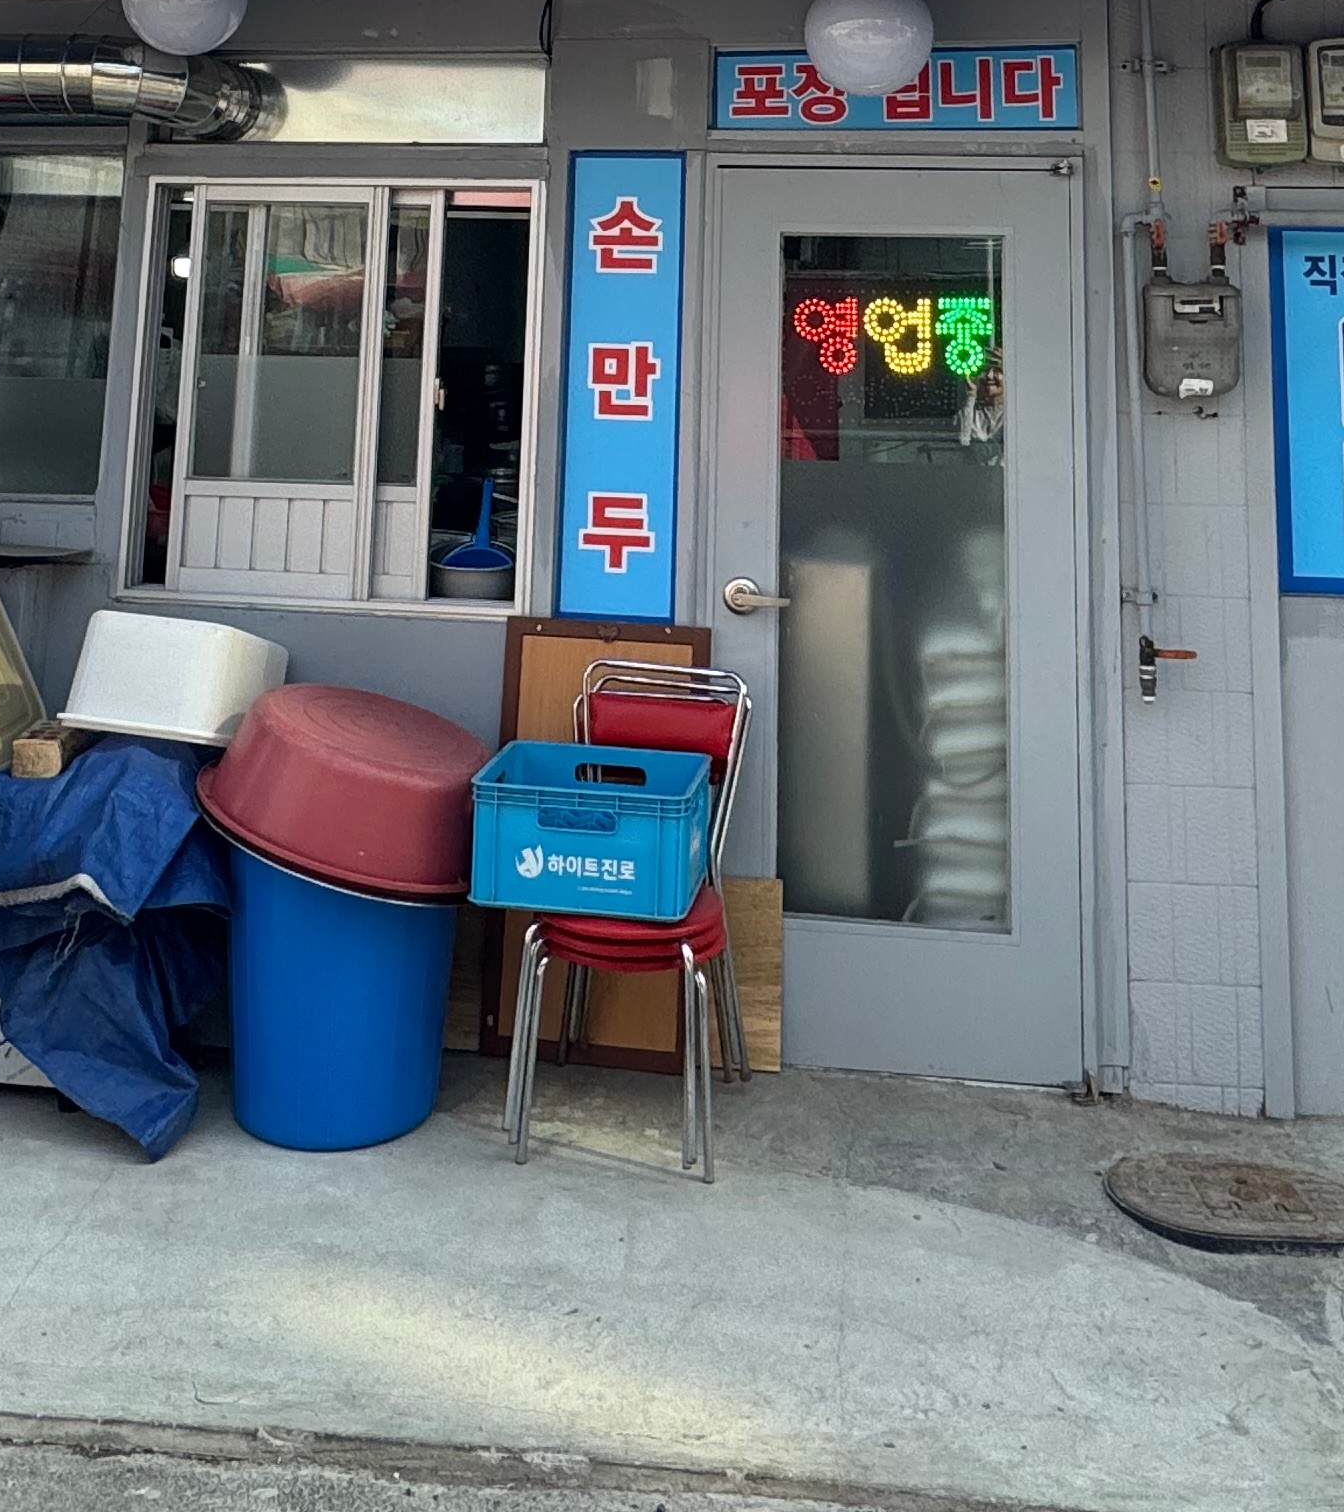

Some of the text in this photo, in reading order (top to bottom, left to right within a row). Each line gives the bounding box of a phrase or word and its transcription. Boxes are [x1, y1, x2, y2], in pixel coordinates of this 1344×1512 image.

[794, 296, 993, 375] 영업중
[579, 196, 663, 574] 손만두
[547, 854, 636, 881] 하이트진로
